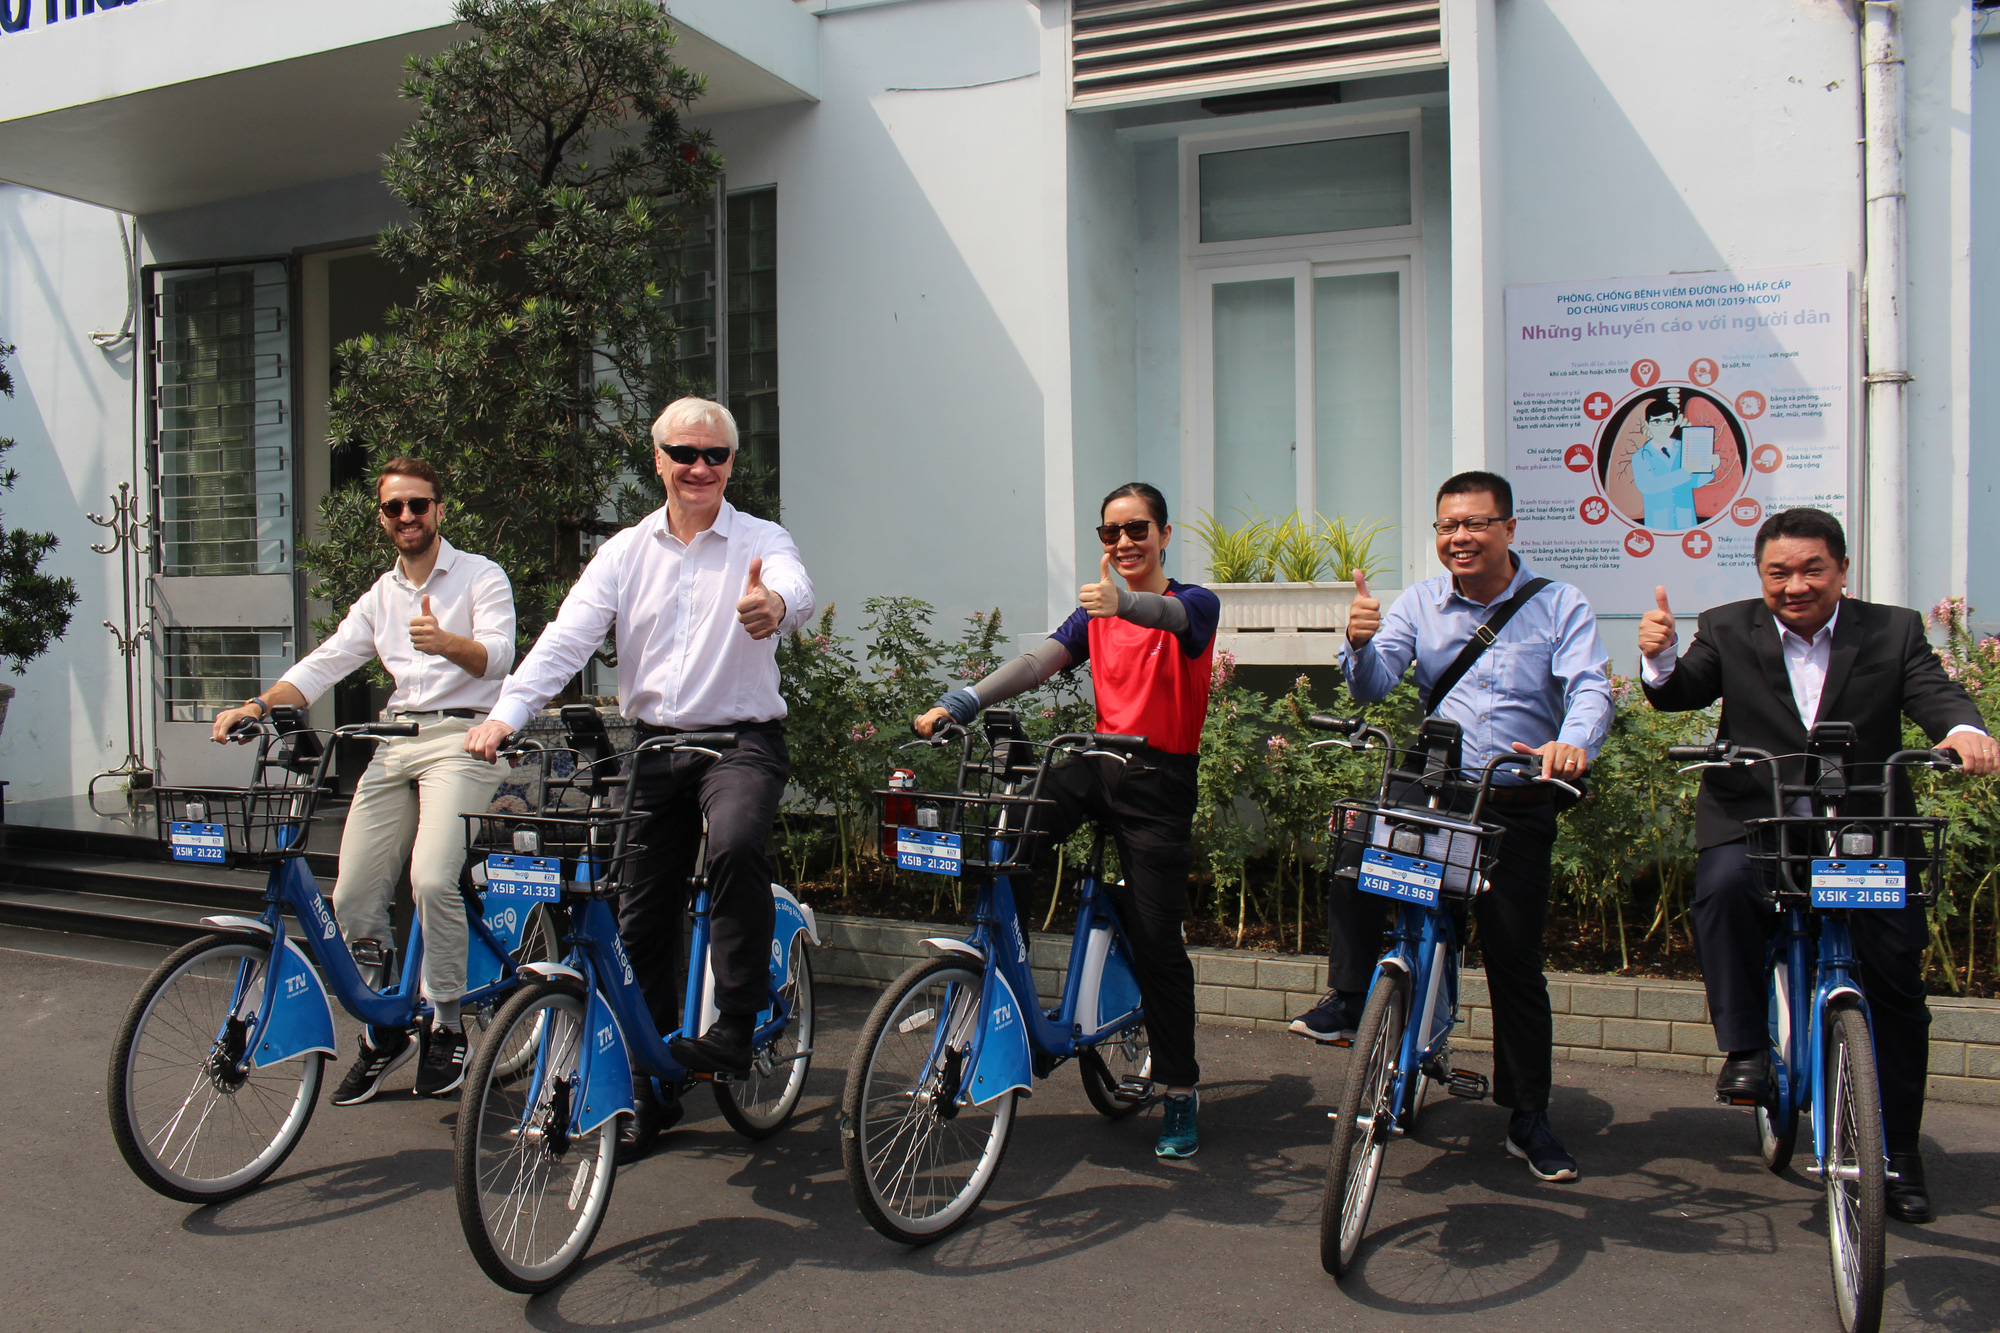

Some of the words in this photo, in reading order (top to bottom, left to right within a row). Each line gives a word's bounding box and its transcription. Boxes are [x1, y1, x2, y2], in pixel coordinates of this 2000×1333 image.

[1558, 294, 1594, 303] PHÒNG,
[1596, 290, 1632, 300] CHỐNG
[1634, 289, 1660, 300] BỆNH
[1663, 287, 1686, 297] VIÊM
[1689, 285, 1727, 296] ĐƯỜNG
[1730, 283, 1744, 293] HÔ
[1748, 281, 1768, 292] HẤP
[1771, 279, 1791, 290] CẤP
[1567, 306, 1582, 315] DO
[1584, 303, 1618, 314] CHỦNG
[1621, 302, 1649, 312] VIRUS
[1651, 300, 1693, 310] CORONA
[1696, 297, 1715, 307] MỚI
[1718, 294, 1781, 306] (2019-NCOV)
[1522, 324, 1582, 341] Những
[1587, 317, 1655, 339] khuyến
[1661, 317, 1692, 332] cáo
[1698, 315, 1726, 330] với
[1732, 311, 1788, 331] người
[1793, 309, 1830, 324] dân
[197, 848, 222, 858] 21.222
[902, 855, 921, 866] X51B
[928, 858, 957, 871] 21.202
[492, 882, 515, 894] X51B
[522, 885, 556, 897] 21.333
[1364, 876, 1390, 891] X51B
[1397, 884, 1434, 901] 21.969
[1818, 891, 1847, 902] X51K
[1857, 891, 1900, 902] 21.666
[482, 907, 516, 935] NGO
[285, 972, 306, 993] TN
[993, 1004, 1011, 1024] TN
[597, 1024, 613, 1047] TN
